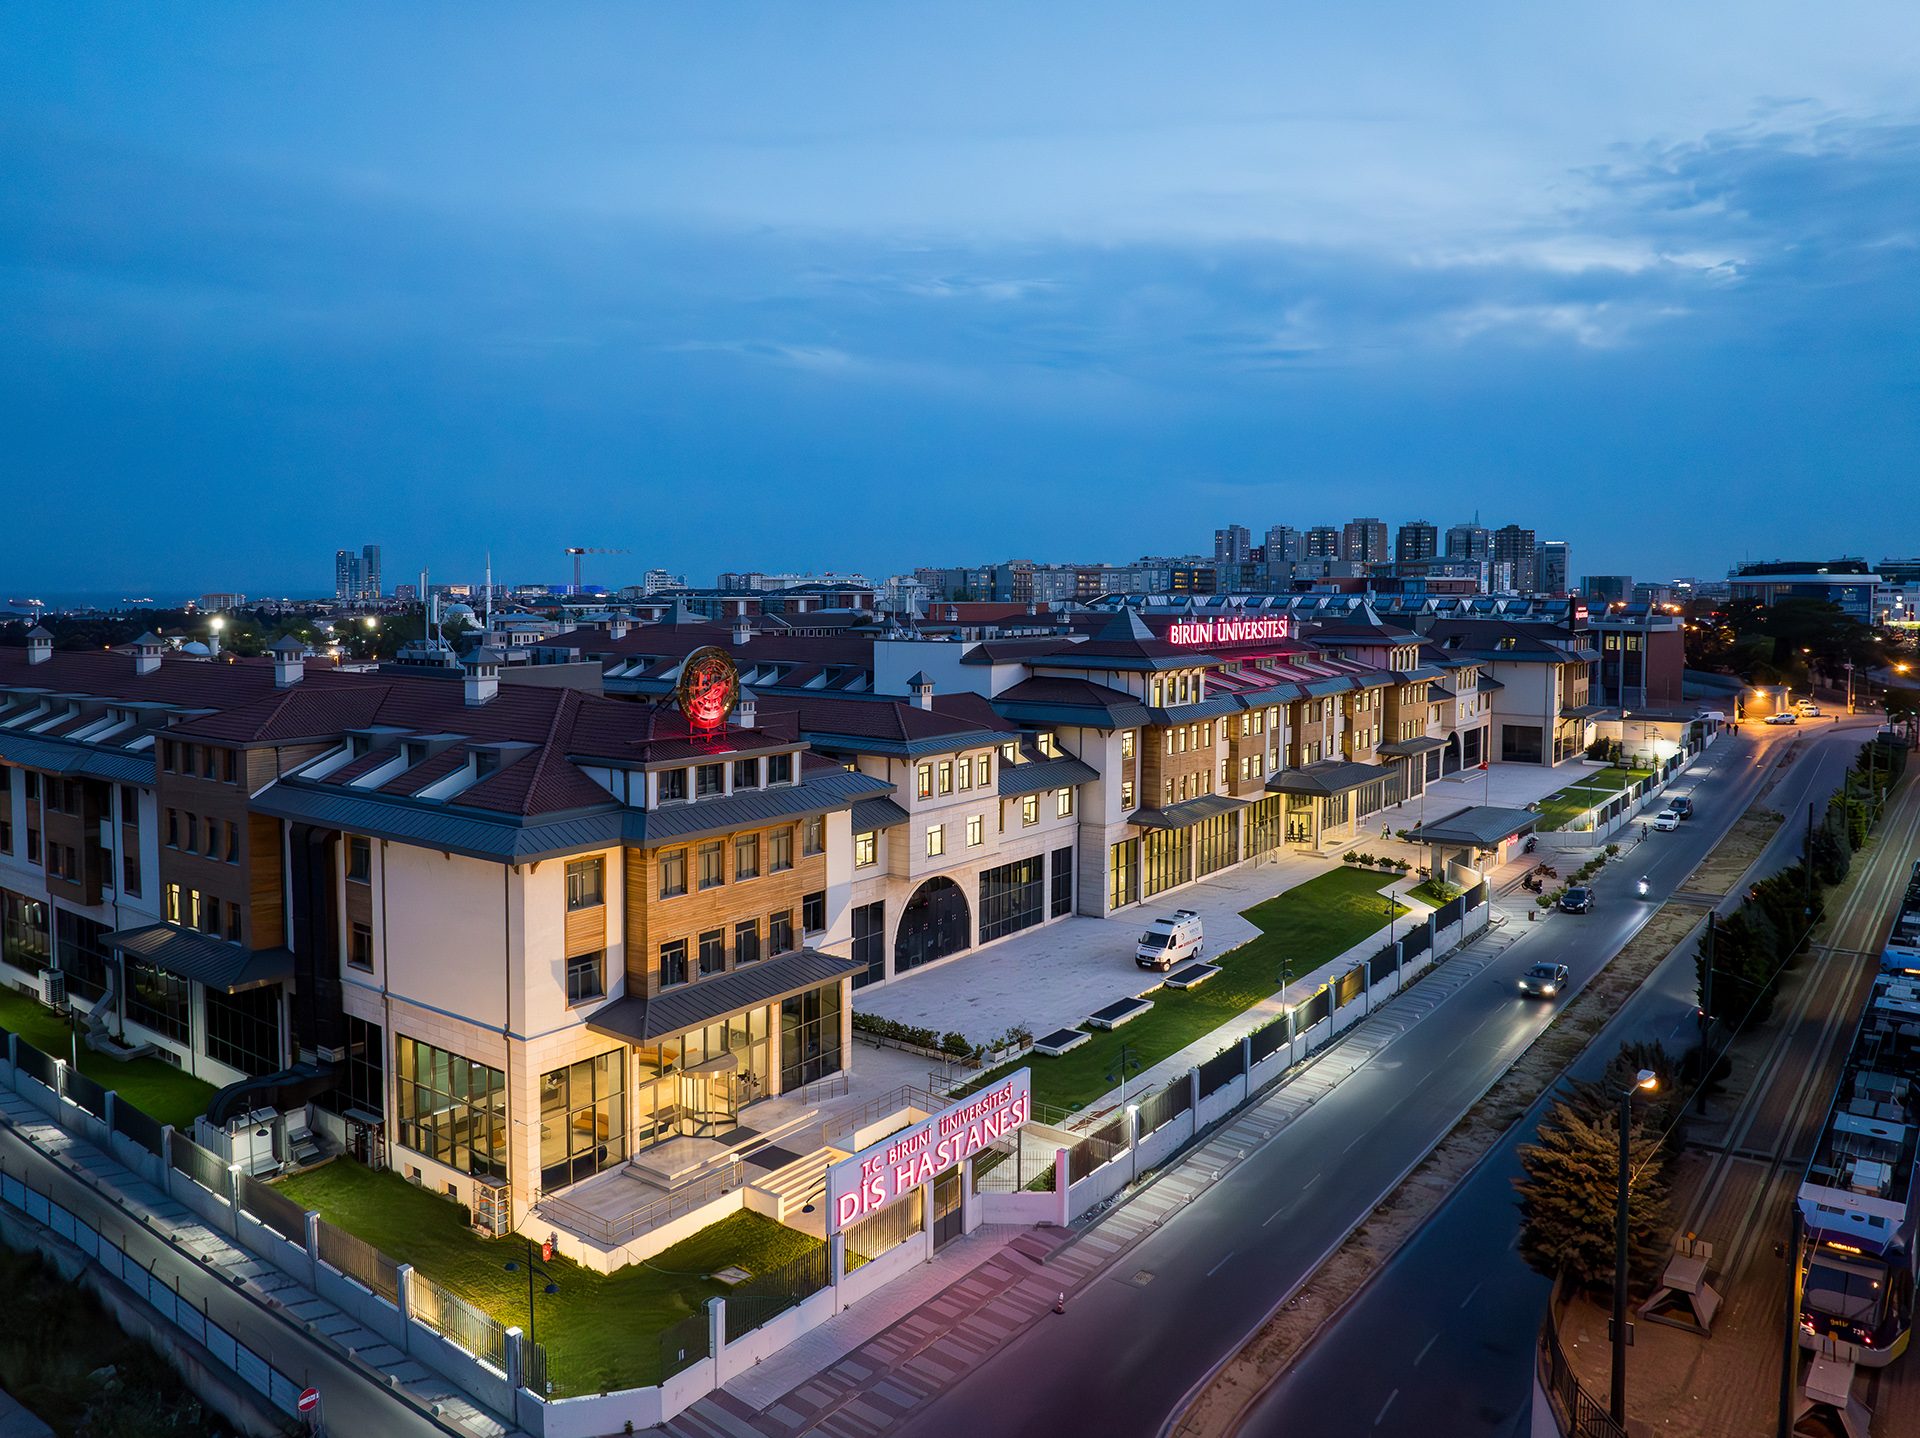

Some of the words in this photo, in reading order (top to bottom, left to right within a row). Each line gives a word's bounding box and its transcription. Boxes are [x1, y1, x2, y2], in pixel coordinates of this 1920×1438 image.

[1217, 615, 1288, 642] ÜNİVERSİTESİ
[838, 1174, 887, 1228] DİŞ
[895, 1090, 1028, 1196] HASTANESİ
[862, 1155, 885, 1178] T.C.
[888, 1124, 932, 1166] BİRUNİ
[939, 1081, 1013, 1136] ÜNİVERSİTESİ
